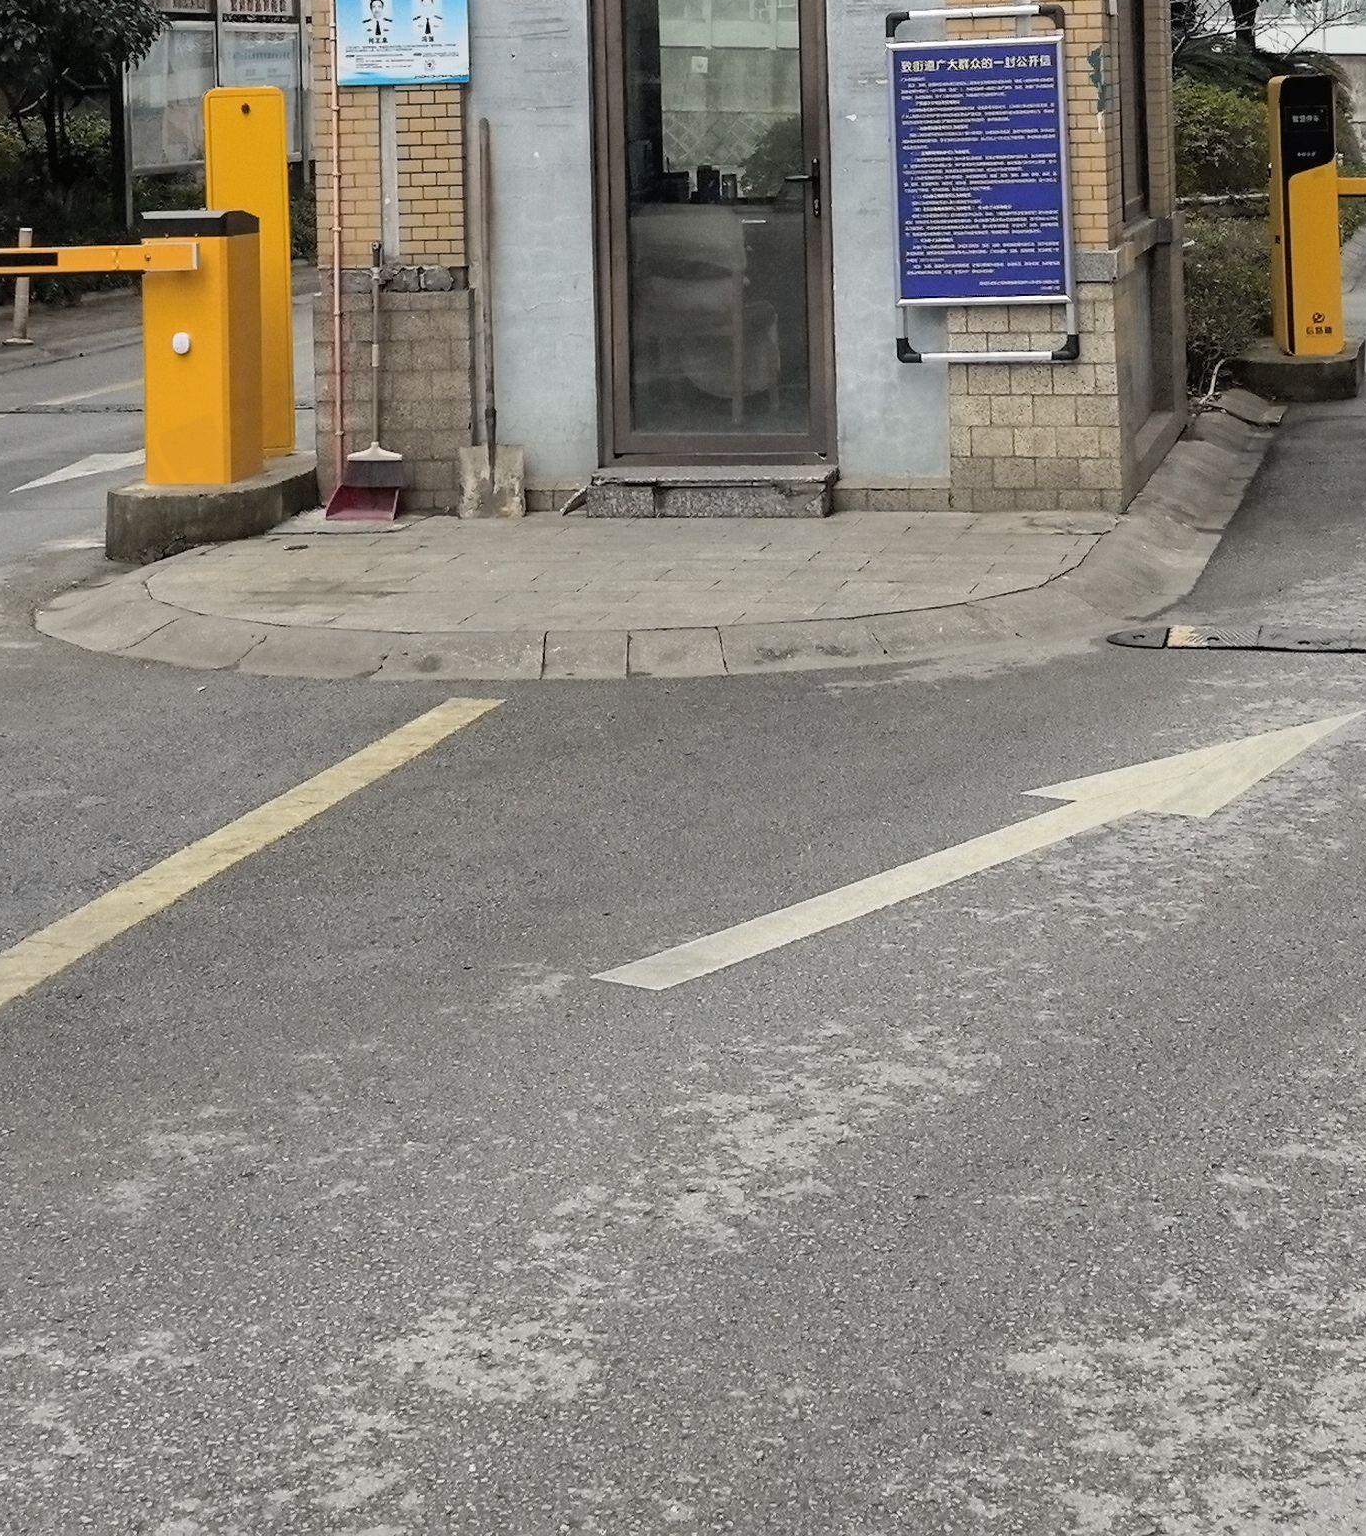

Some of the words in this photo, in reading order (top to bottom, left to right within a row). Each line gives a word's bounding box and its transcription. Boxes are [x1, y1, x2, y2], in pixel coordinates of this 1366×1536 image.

[900, 54, 1052, 73] 致街道广大群众的一封公开信
